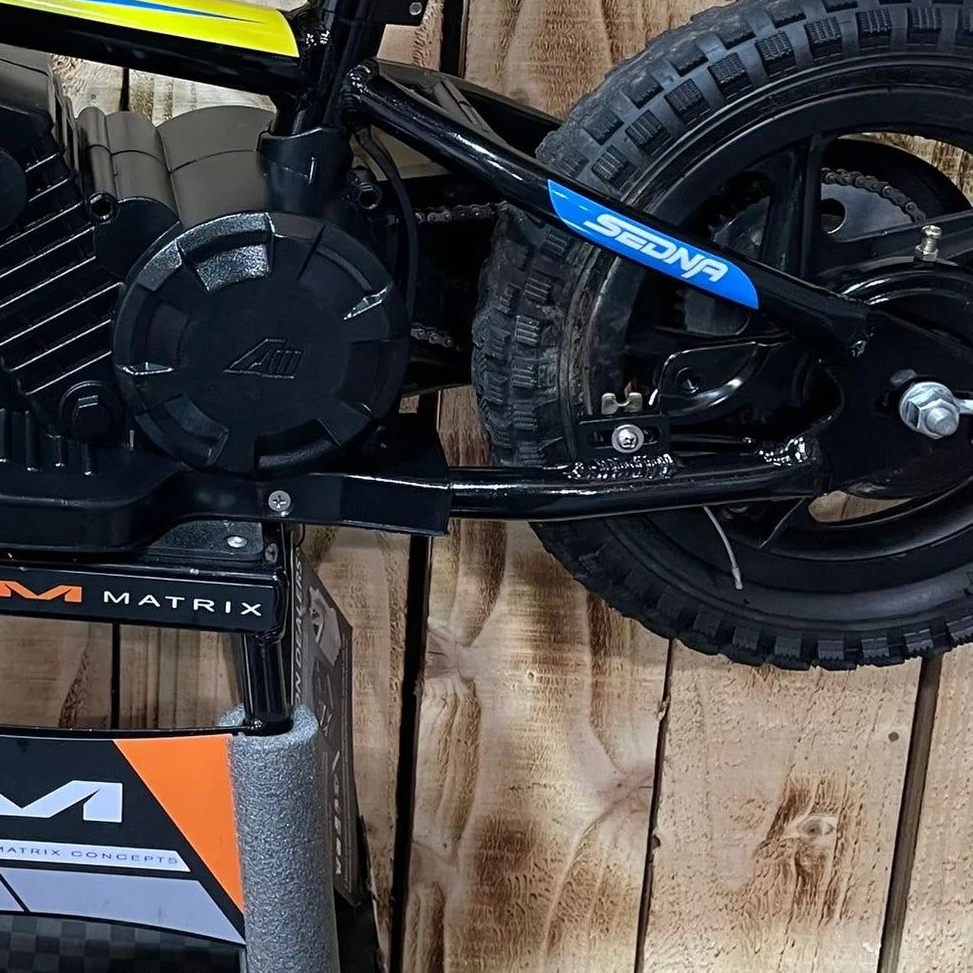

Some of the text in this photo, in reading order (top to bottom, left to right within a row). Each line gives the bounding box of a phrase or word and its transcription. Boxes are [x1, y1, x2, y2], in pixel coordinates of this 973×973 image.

[583, 213, 728, 282] SEDNA
[103, 590, 262, 617] MATRIX
[70, 850, 179, 866] CONCEPTS
